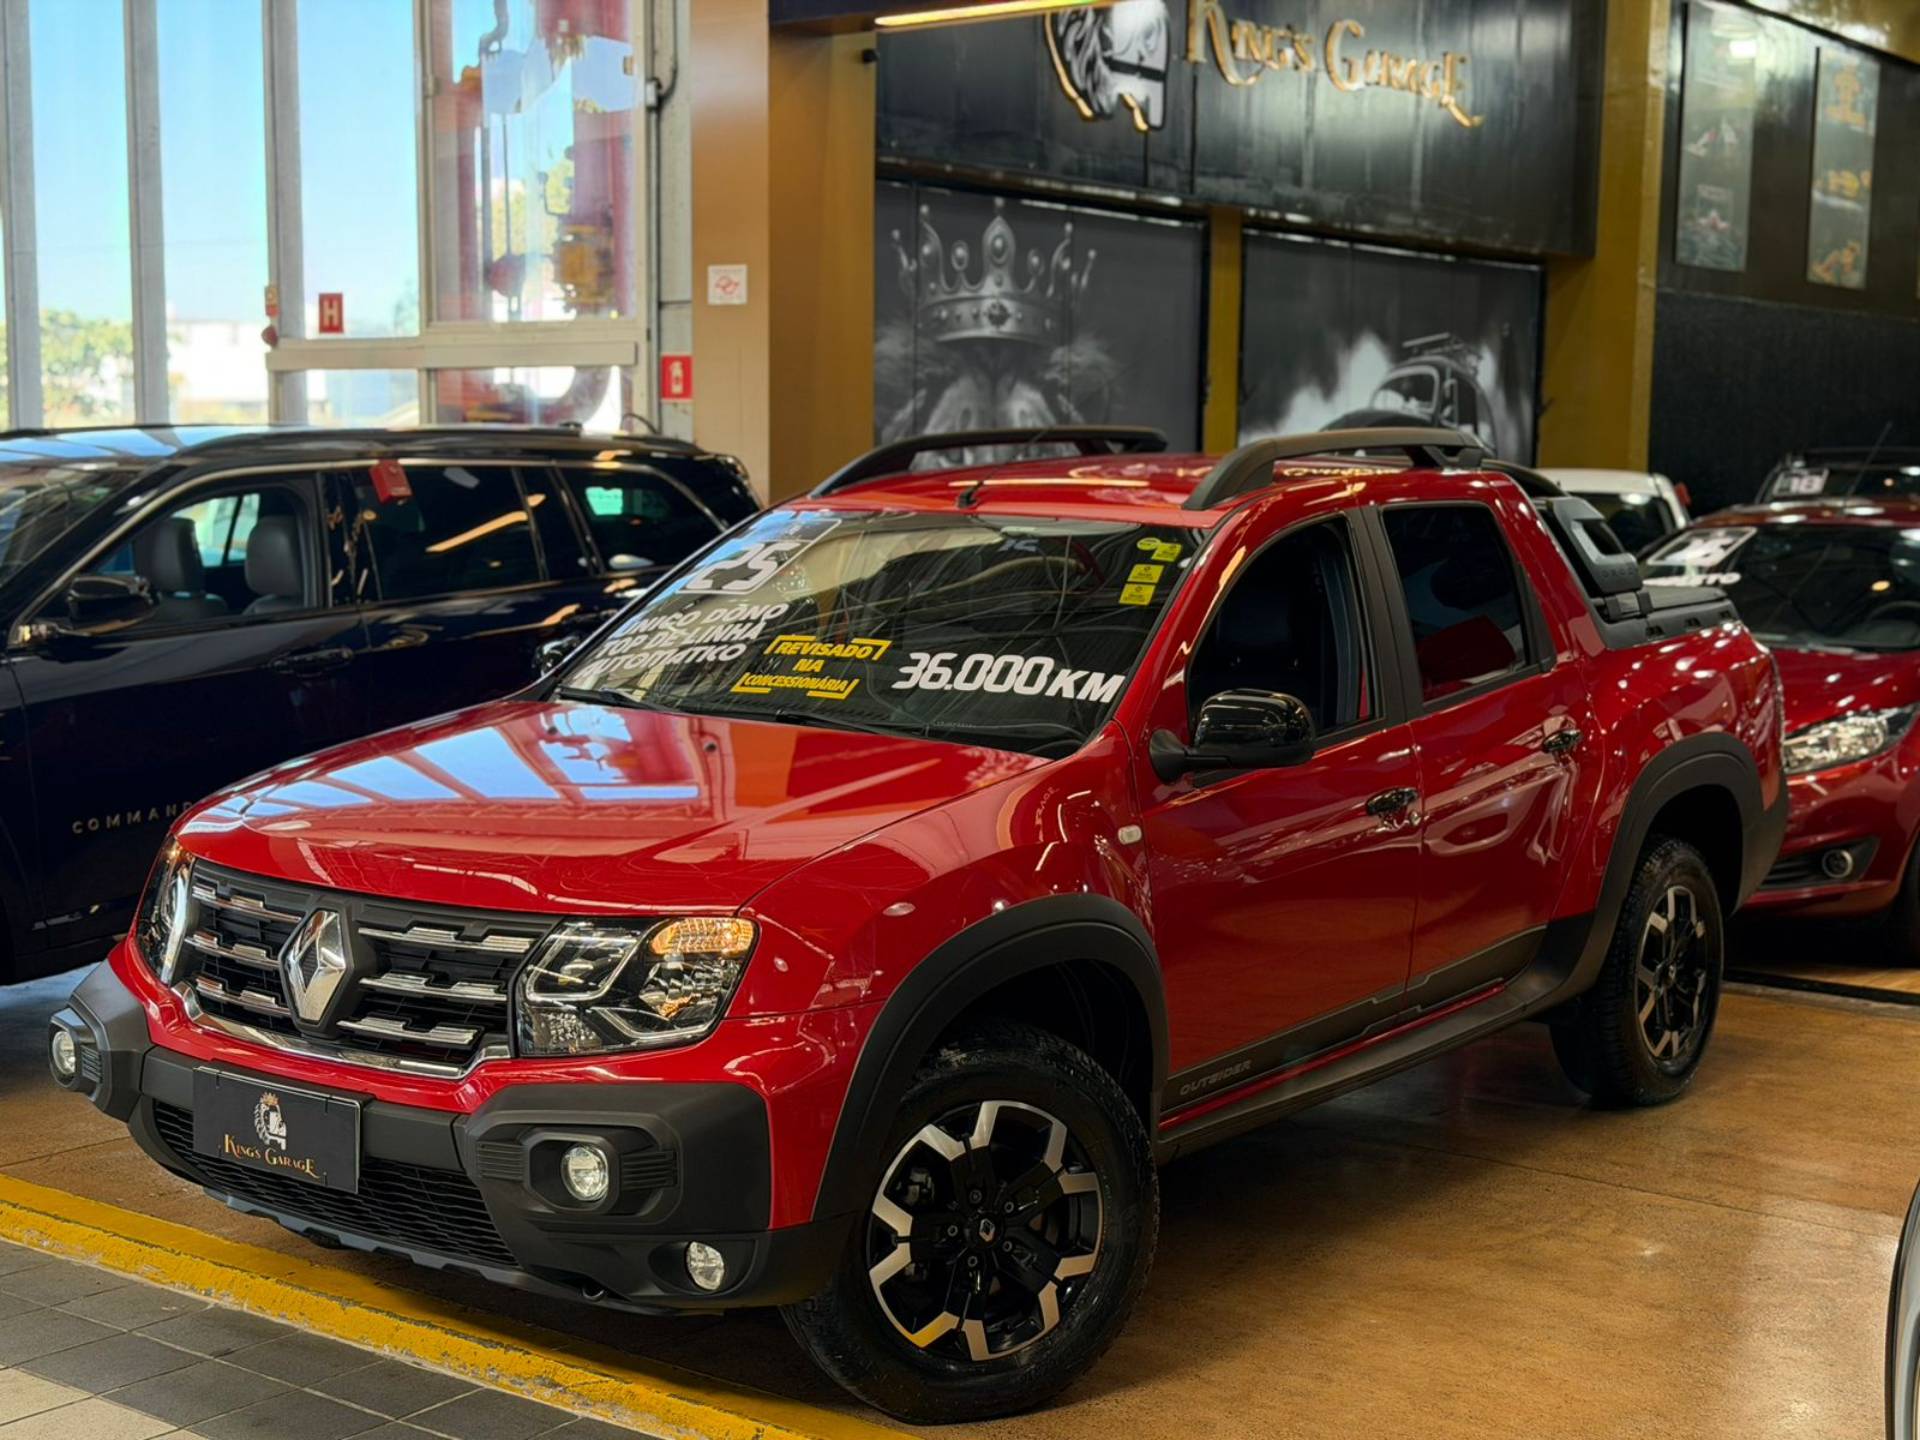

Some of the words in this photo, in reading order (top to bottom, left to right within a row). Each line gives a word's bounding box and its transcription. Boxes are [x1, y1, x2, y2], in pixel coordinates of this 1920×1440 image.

[685, 541, 801, 590] 25
[700, 603, 790, 624] DONO
[641, 629, 681, 650] DE
[681, 619, 767, 645] LINHA
[775, 641, 873, 659] REVISADO
[792, 658, 825, 673] NA
[892, 652, 1053, 695] 36.000
[1047, 668, 1127, 703] KM
[1180, 1060, 1252, 1095] OUTSIDER
